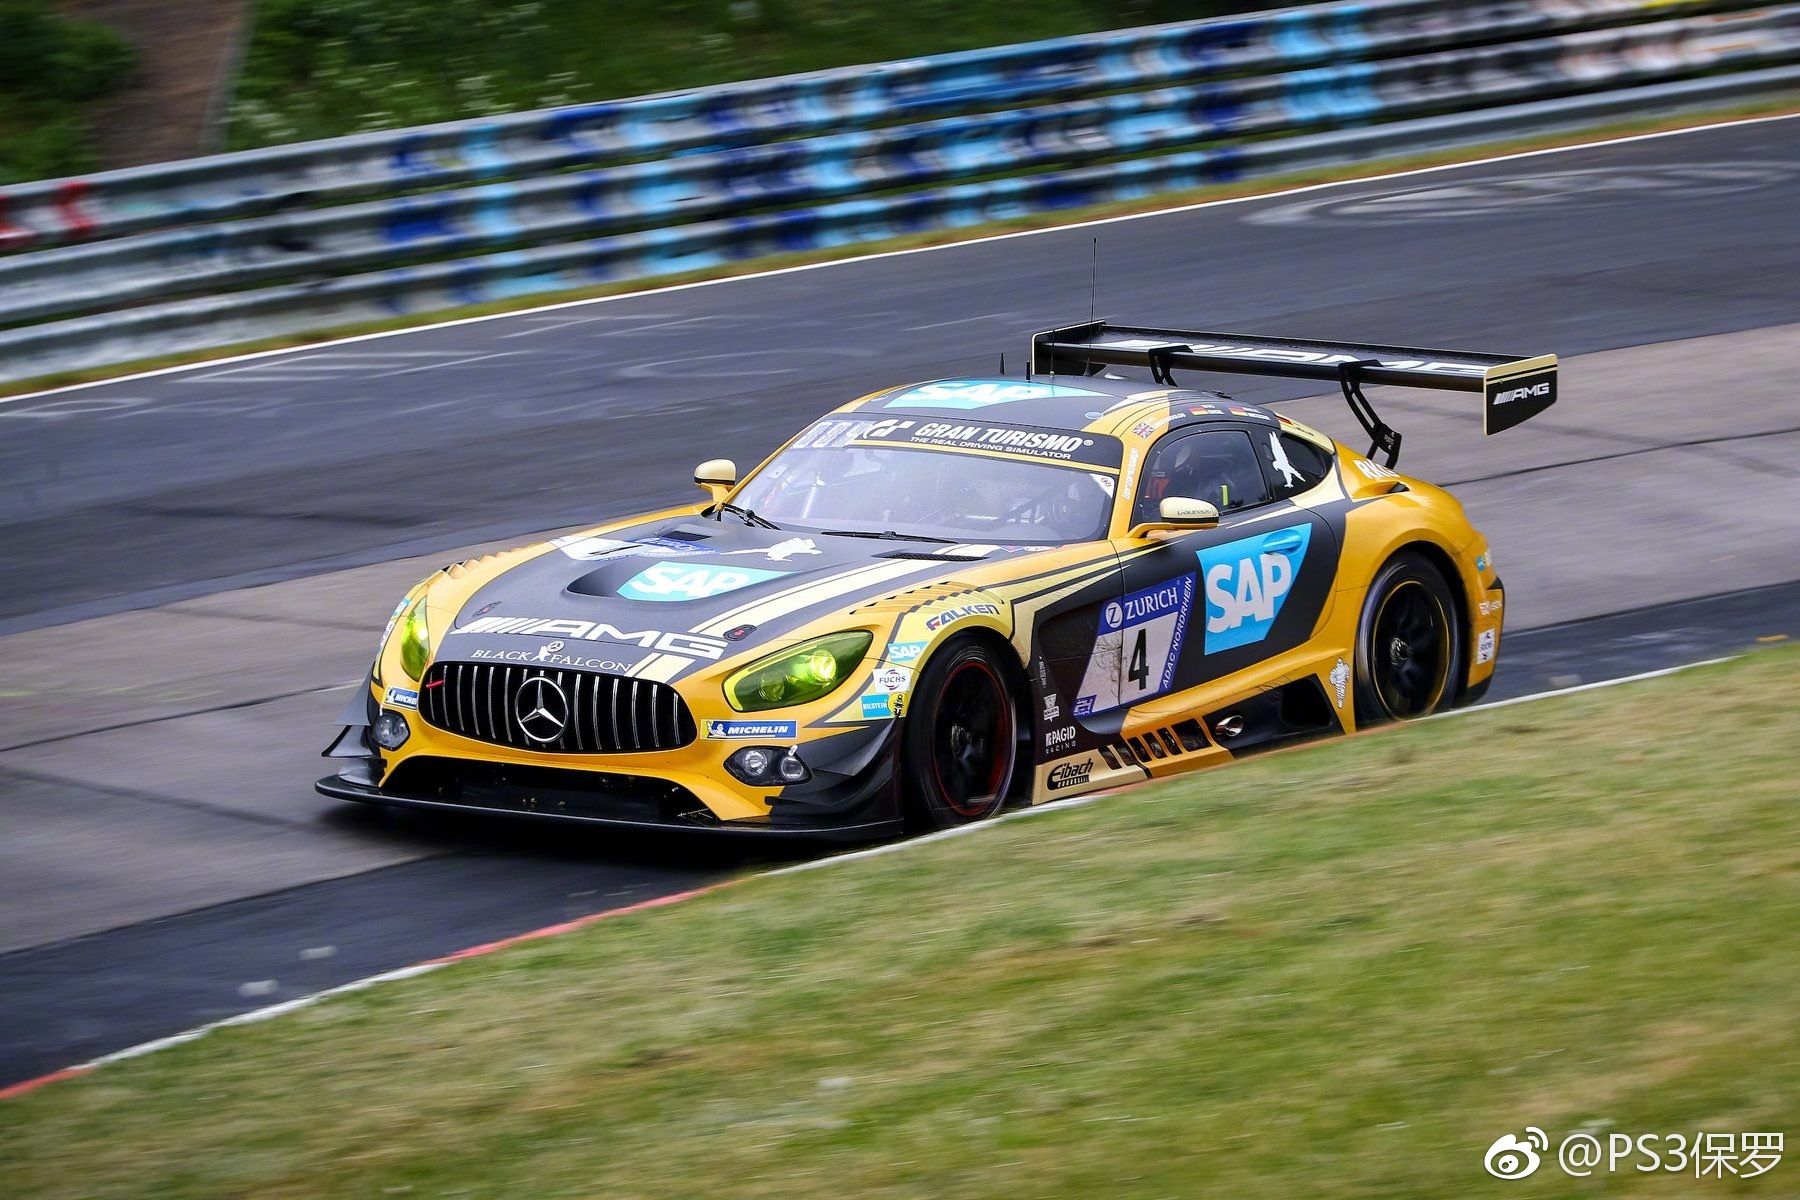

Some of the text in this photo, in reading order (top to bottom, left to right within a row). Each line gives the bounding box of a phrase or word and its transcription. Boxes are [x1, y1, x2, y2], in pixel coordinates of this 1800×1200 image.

[900, 383, 1048, 402] SAP
[914, 422, 982, 440] GRAN
[930, 438, 957, 446] REAL
[959, 441, 1004, 451] DRIVING
[1005, 446, 1072, 460] SIMULATOR
[630, 567, 751, 597] SAP
[1207, 552, 1292, 633] SAP
[1124, 586, 1178, 620] ZURICH
[926, 604, 1000, 631] FALKEN
[520, 619, 728, 660] AMG
[1162, 576, 1193, 689] ADAC NORDRHEIN
[470, 649, 633, 672] BLACK FALCON
[889, 645, 920, 659] SAP
[1128, 628, 1149, 691] 4
[879, 675, 906, 684] FUCHS
[862, 701, 888, 710] BILSTEIN
[727, 725, 789, 735] MICHELIN
[1051, 726, 1076, 745] PAGID
[1047, 758, 1094, 791] Eibach
